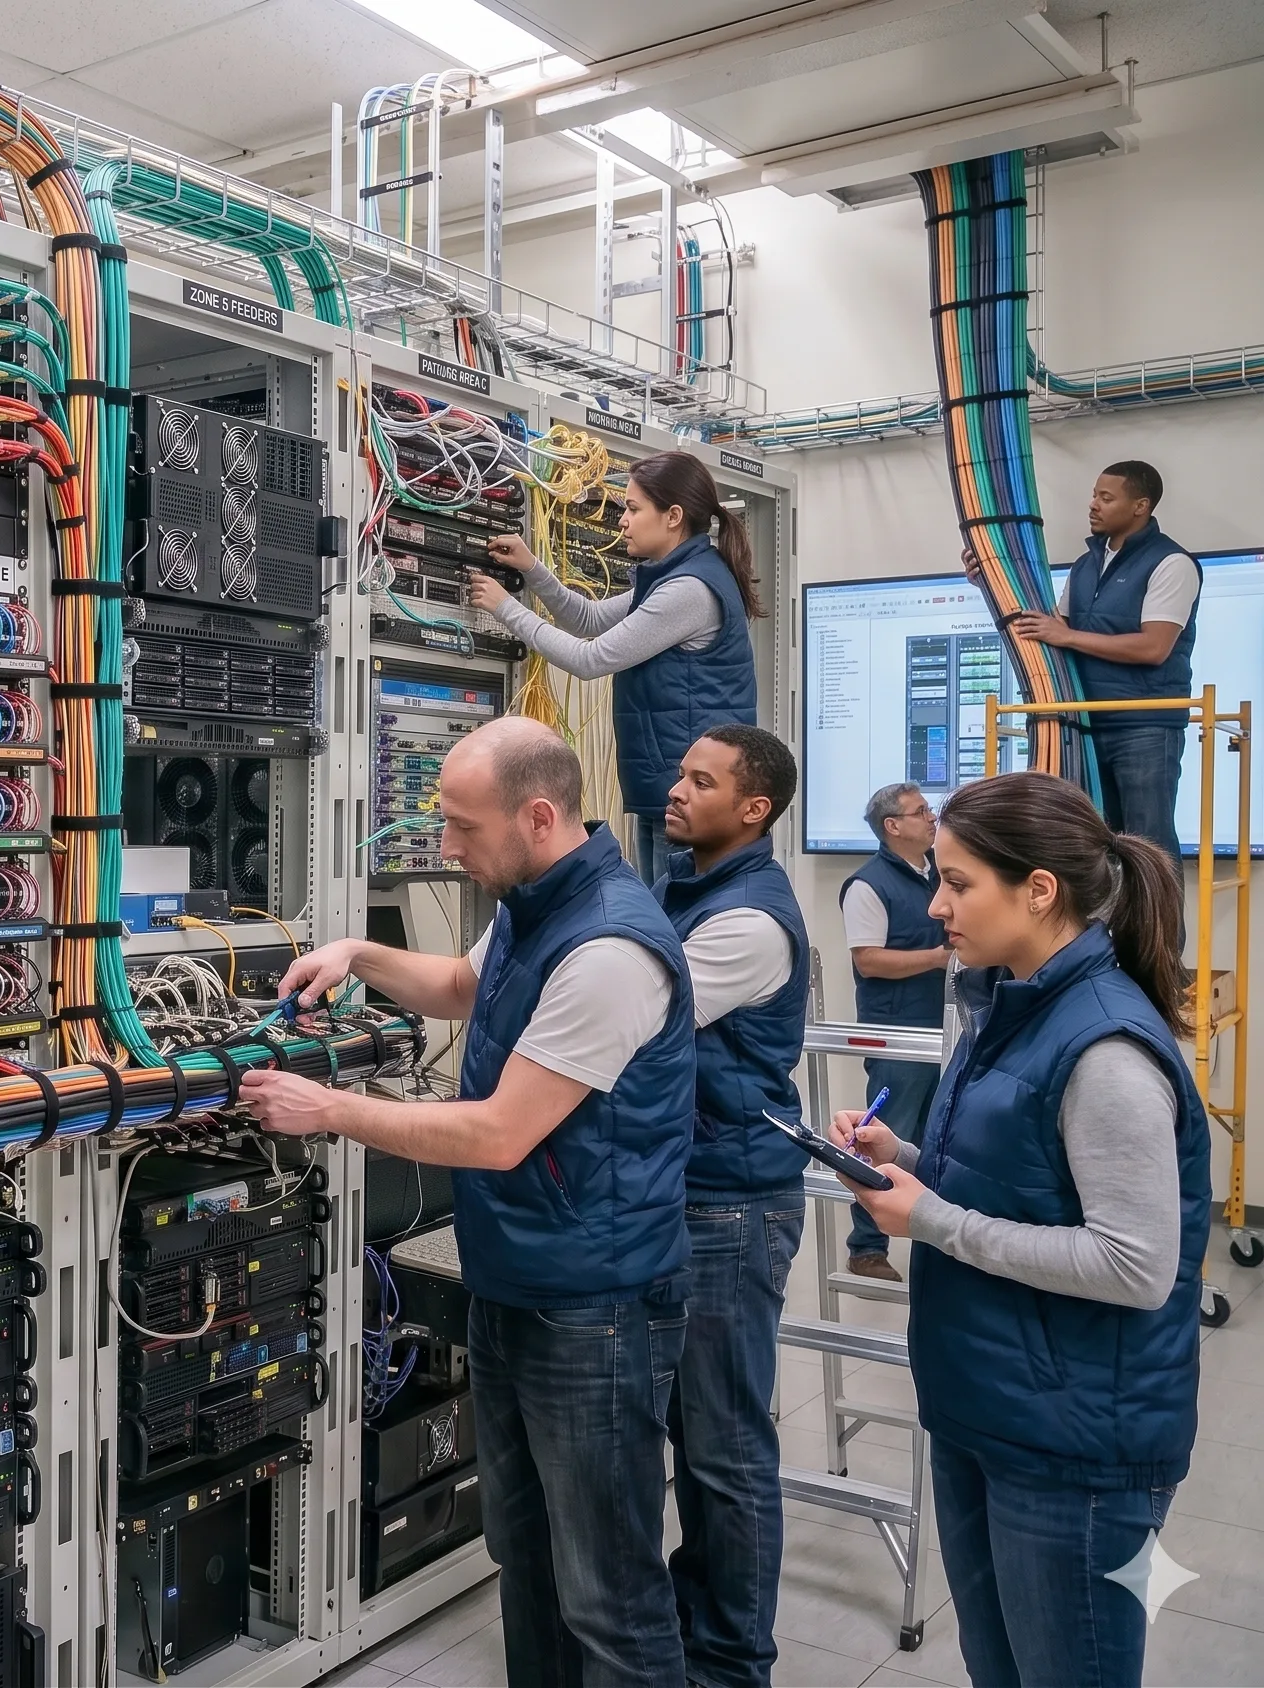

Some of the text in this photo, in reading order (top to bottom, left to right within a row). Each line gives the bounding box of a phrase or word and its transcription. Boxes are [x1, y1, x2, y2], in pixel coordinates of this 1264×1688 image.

[190, 287, 278, 326] ZONE 5 FEEDERS
